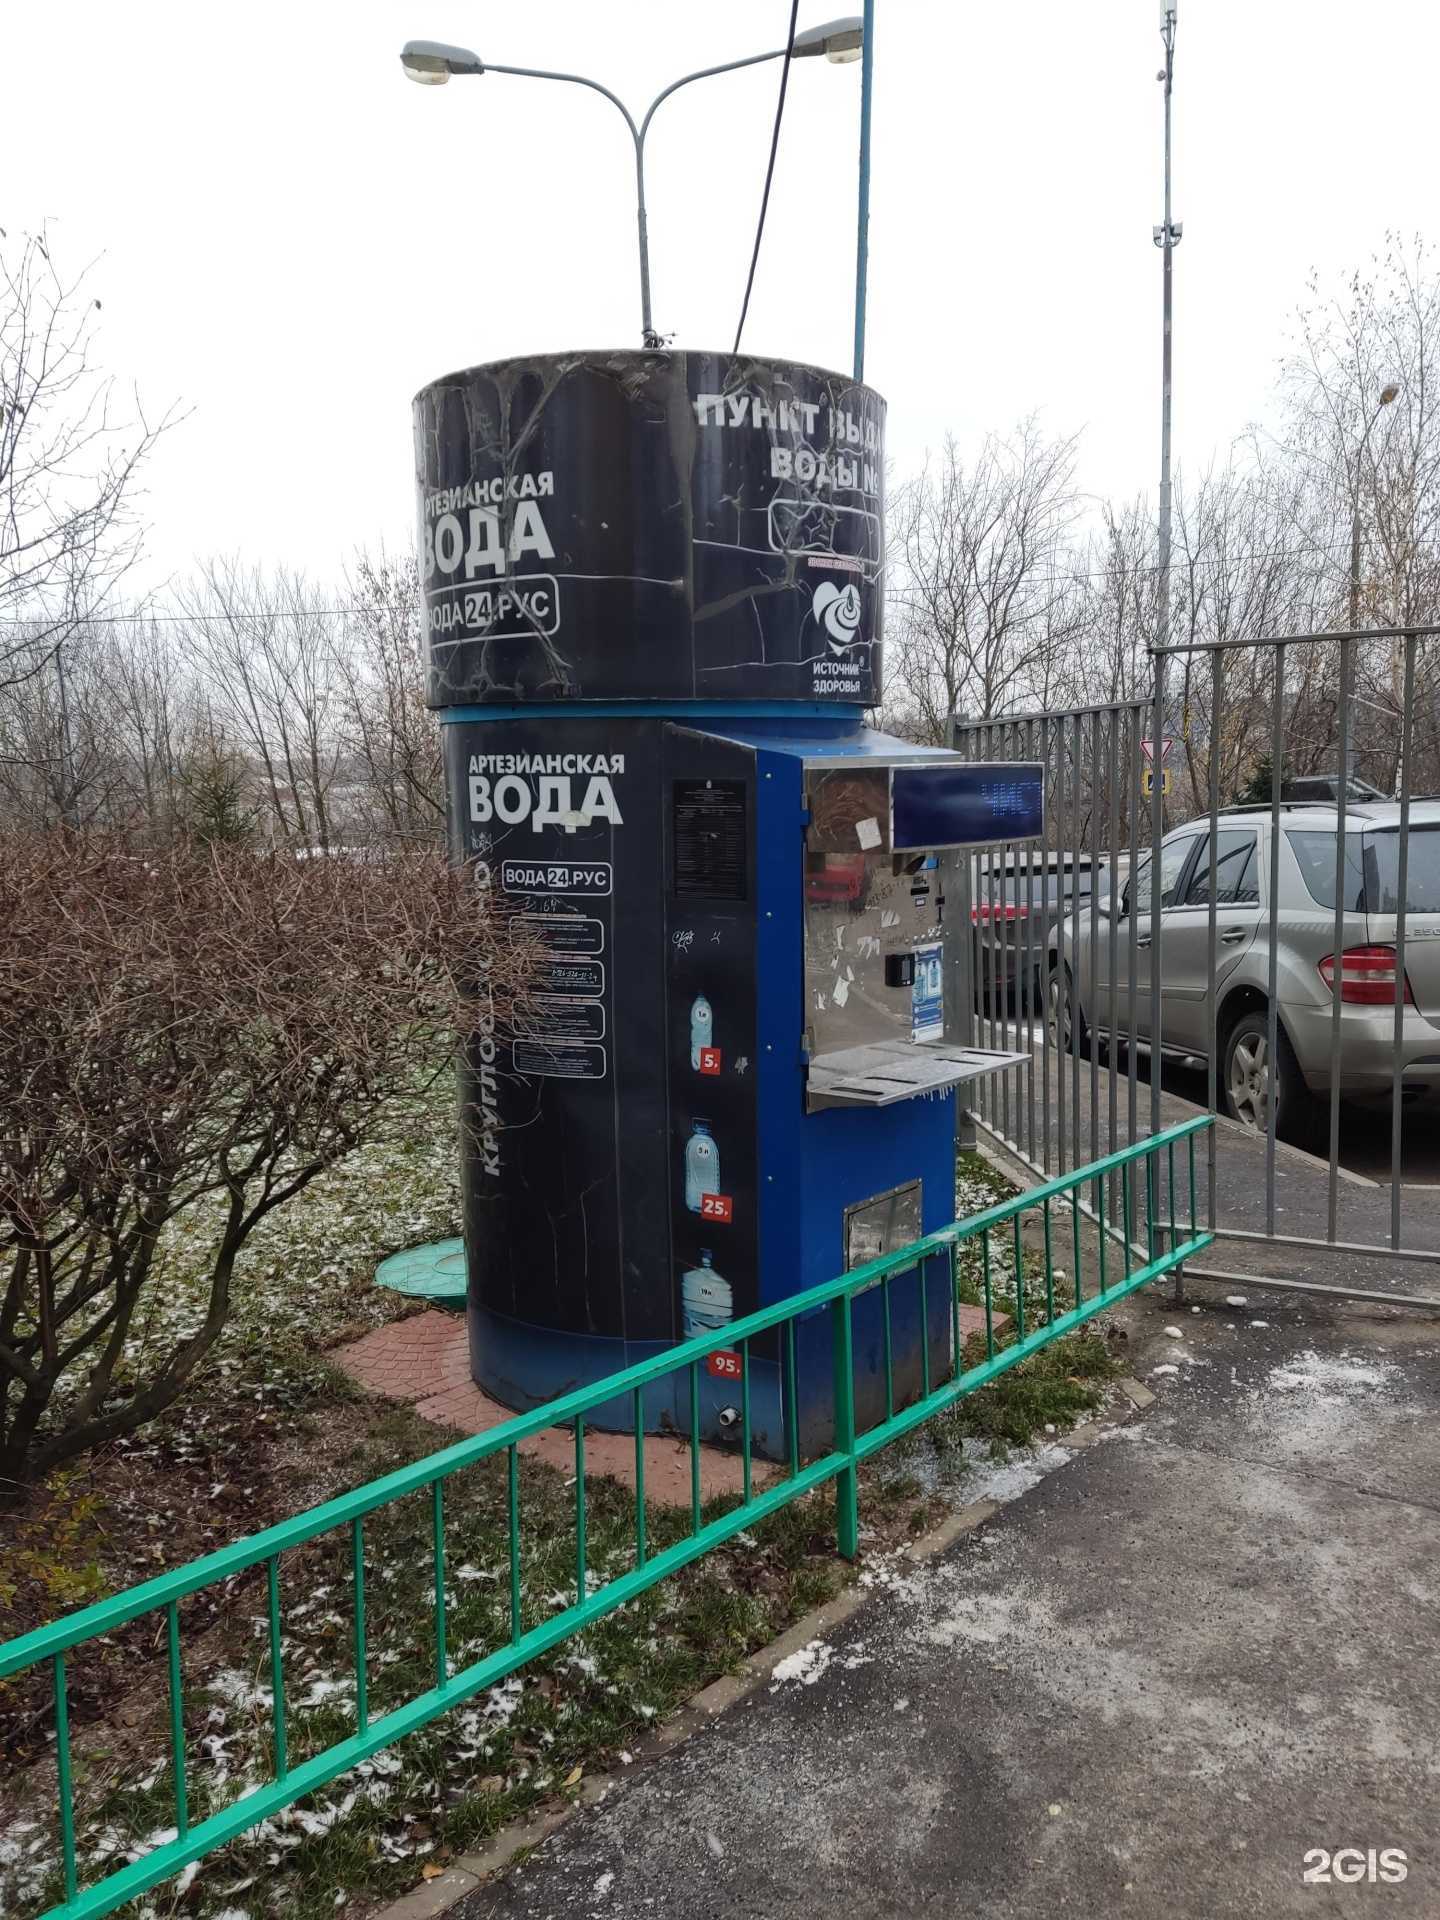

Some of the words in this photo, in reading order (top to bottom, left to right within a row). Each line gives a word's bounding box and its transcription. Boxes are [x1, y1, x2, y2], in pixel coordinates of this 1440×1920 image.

[697, 393, 820, 435] ПУНКТ
[770, 446, 858, 490] ВОДЫ
[424, 470, 555, 519] РТЕЗИАНСКАЯ
[423, 499, 556, 580] ВОДА
[813, 661, 860, 676] ИСТОЧНИК
[813, 679, 861, 693] ЗДОРОВЬЯ
[468, 753, 625, 775] АРТЕЗИАНСКАЯ
[468, 774, 625, 834] ВОДА
